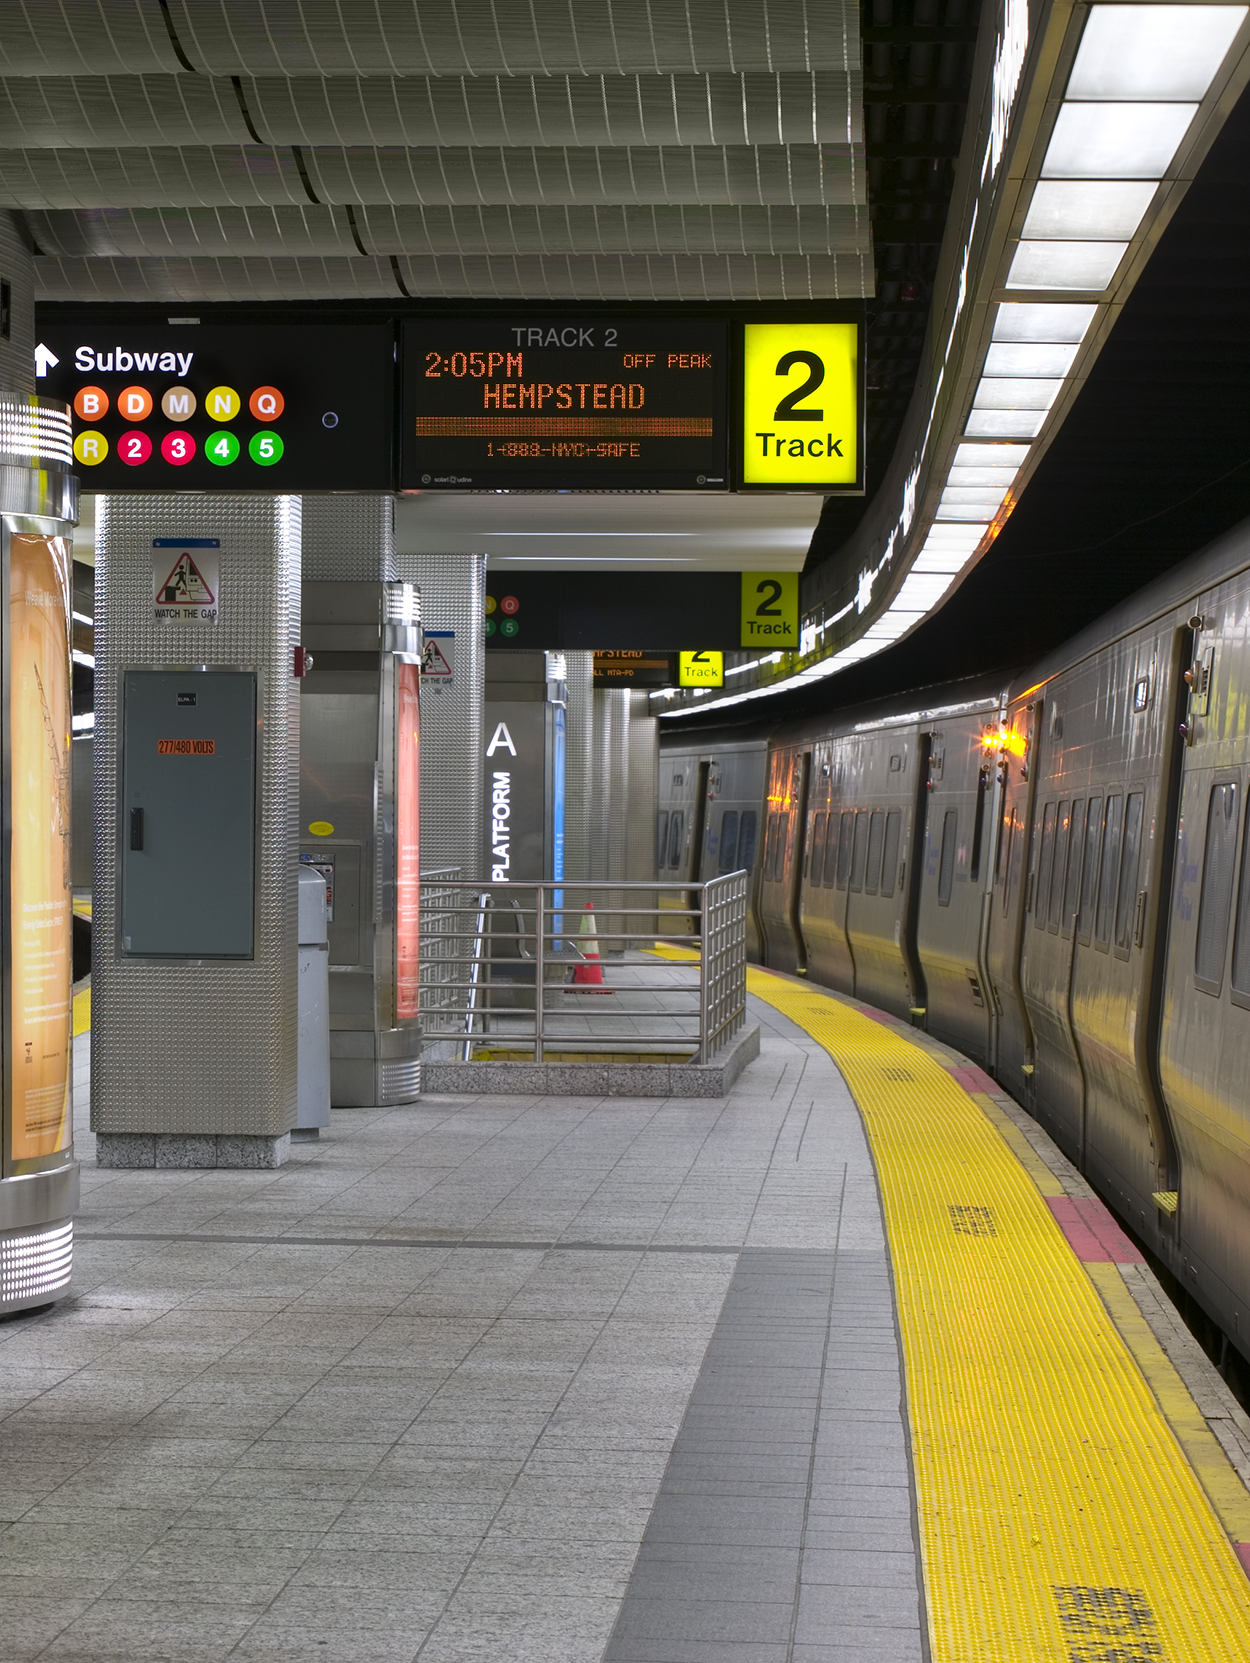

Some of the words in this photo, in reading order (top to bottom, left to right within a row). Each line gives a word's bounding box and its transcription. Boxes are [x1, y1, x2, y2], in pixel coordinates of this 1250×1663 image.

[511, 328, 595, 347] TRACK
[604, 328, 618, 347] 2
[75, 346, 194, 377] Subway
[425, 352, 523, 378] 2:05PM
[623, 354, 656, 368] OFF
[667, 354, 712, 368] PEAK
[484, 383, 645, 409] HEMPSTEAD
[774, 350, 825, 422] 2
[83, 394, 100, 414] B
[127, 394, 145, 414] D
[169, 394, 189, 414] M
[214, 394, 231, 414] N
[257, 394, 276, 414] Q
[83, 439, 99, 458] R
[127, 438, 142, 458] 2
[171, 438, 186, 459] 3
[214, 438, 230, 458] 4
[259, 438, 274, 458] 5
[755, 433, 844, 457] Track
[505, 600, 515, 610] Q
[755, 580, 782, 616] 2
[155, 609, 180, 618] WATCH
[183, 609, 198, 618] THE
[201, 609, 217, 618] GAP
[506, 623, 514, 633] 5
[747, 621, 792, 635] Track
[684, 667, 718, 677] Track
[159, 740, 191, 754] 277/480
[193, 740, 214, 754] VOLTS
[486, 722, 517, 757] A
[492, 771, 511, 882] PLATFORM
